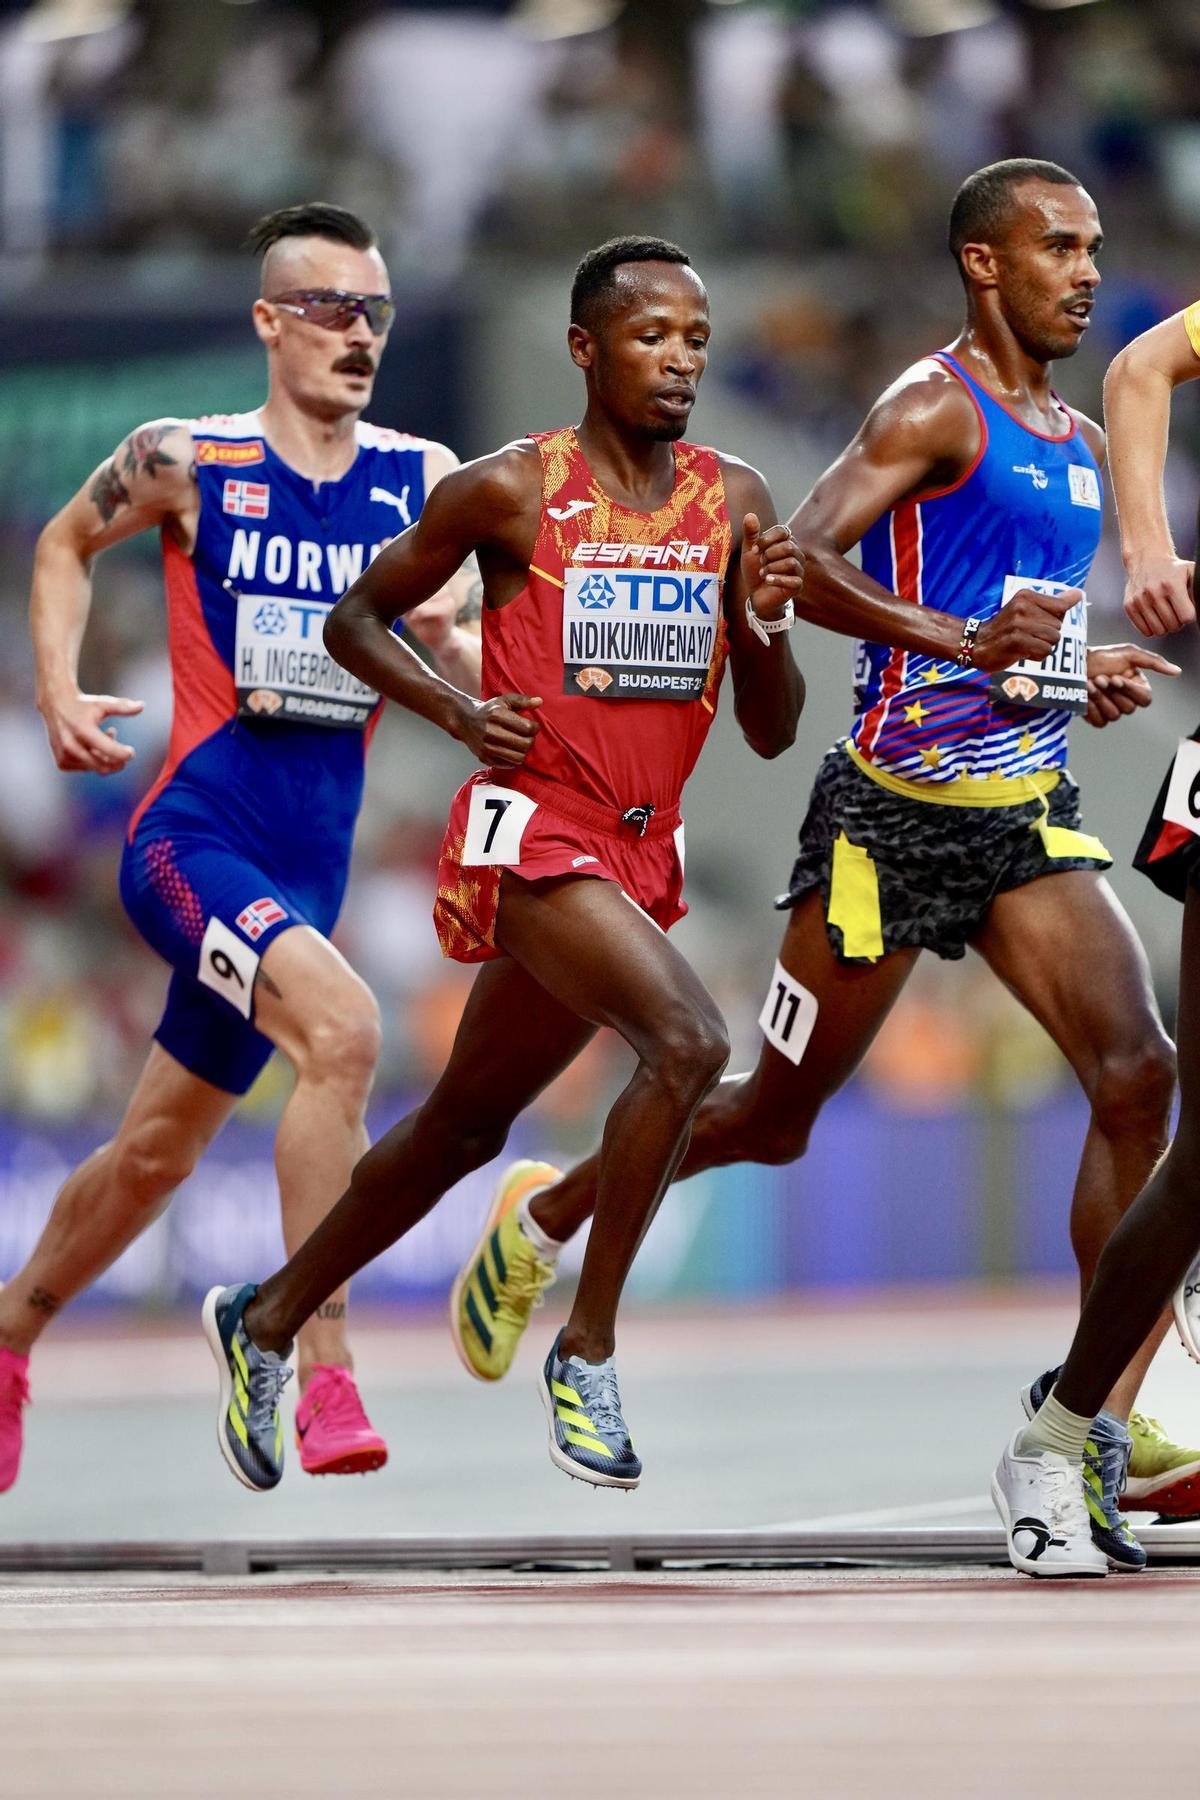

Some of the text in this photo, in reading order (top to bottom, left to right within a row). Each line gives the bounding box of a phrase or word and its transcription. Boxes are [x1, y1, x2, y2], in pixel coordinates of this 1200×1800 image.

[571, 540, 710, 565] ESPAÑA
[615, 574, 712, 615] TDK
[569, 621, 712, 665] NDIKUMWENAYO
[241, 647, 258, 682] H.
[482, 798, 512, 854] 7
[210, 948, 244, 989] 9
[770, 980, 802, 1043] 11
